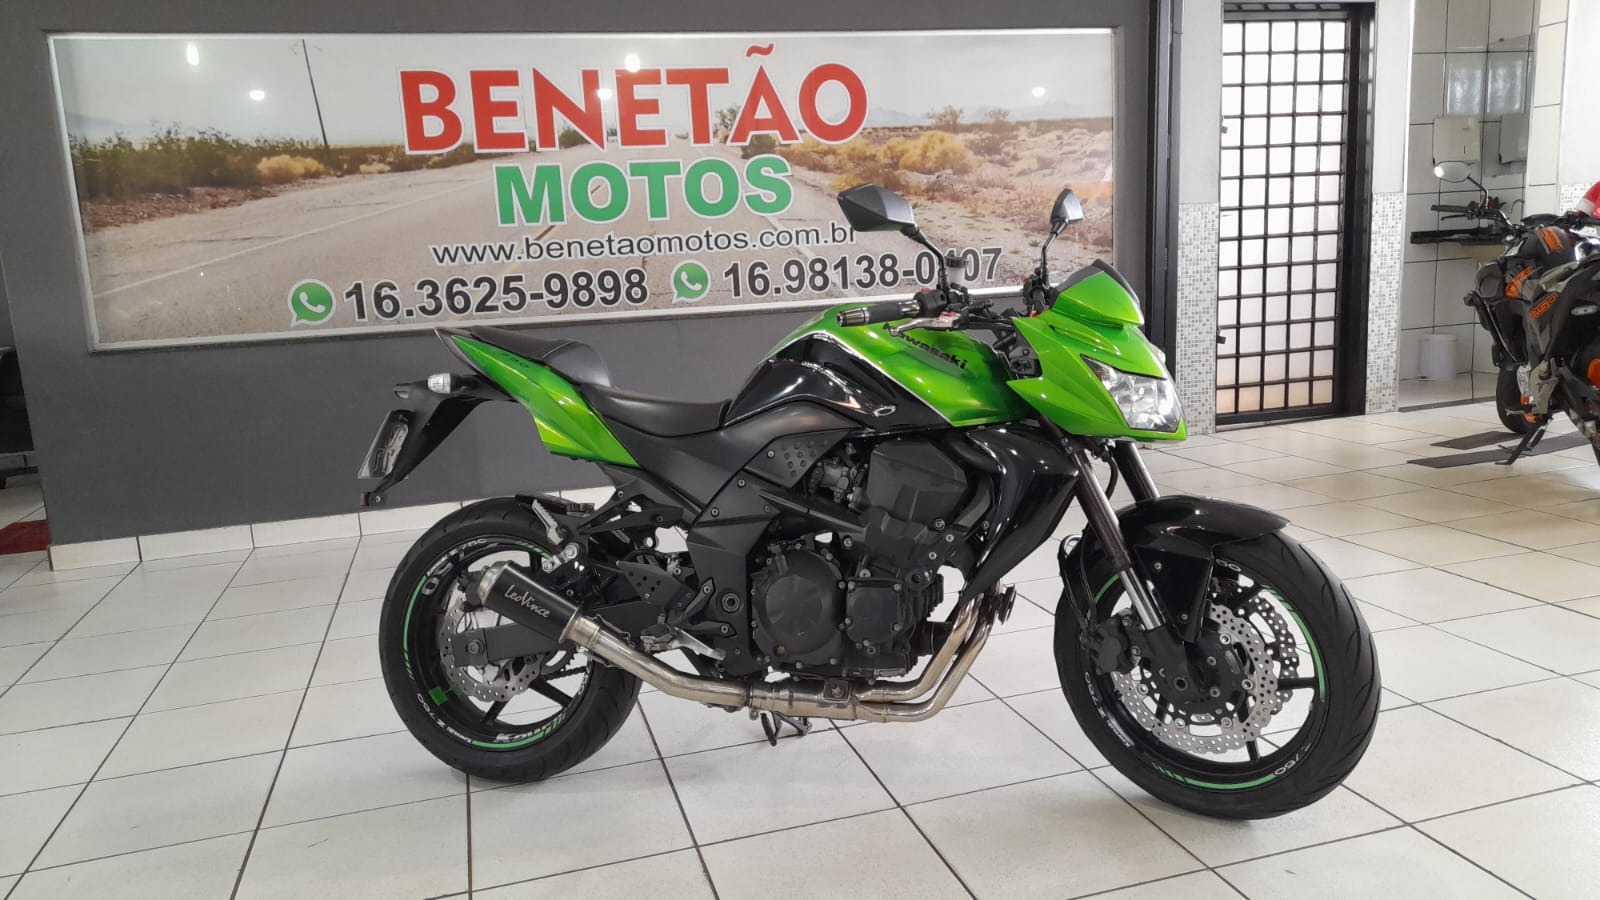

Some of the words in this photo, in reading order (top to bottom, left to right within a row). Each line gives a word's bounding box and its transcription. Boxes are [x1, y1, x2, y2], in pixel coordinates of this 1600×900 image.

[400, 43, 868, 152] BENETÃO
[495, 155, 793, 225] MOTOS
[344, 268, 648, 320] 16.3625-9898
[723, 247, 1002, 297] 16.98138-007
[883, 322, 968, 369] Kwasaki
